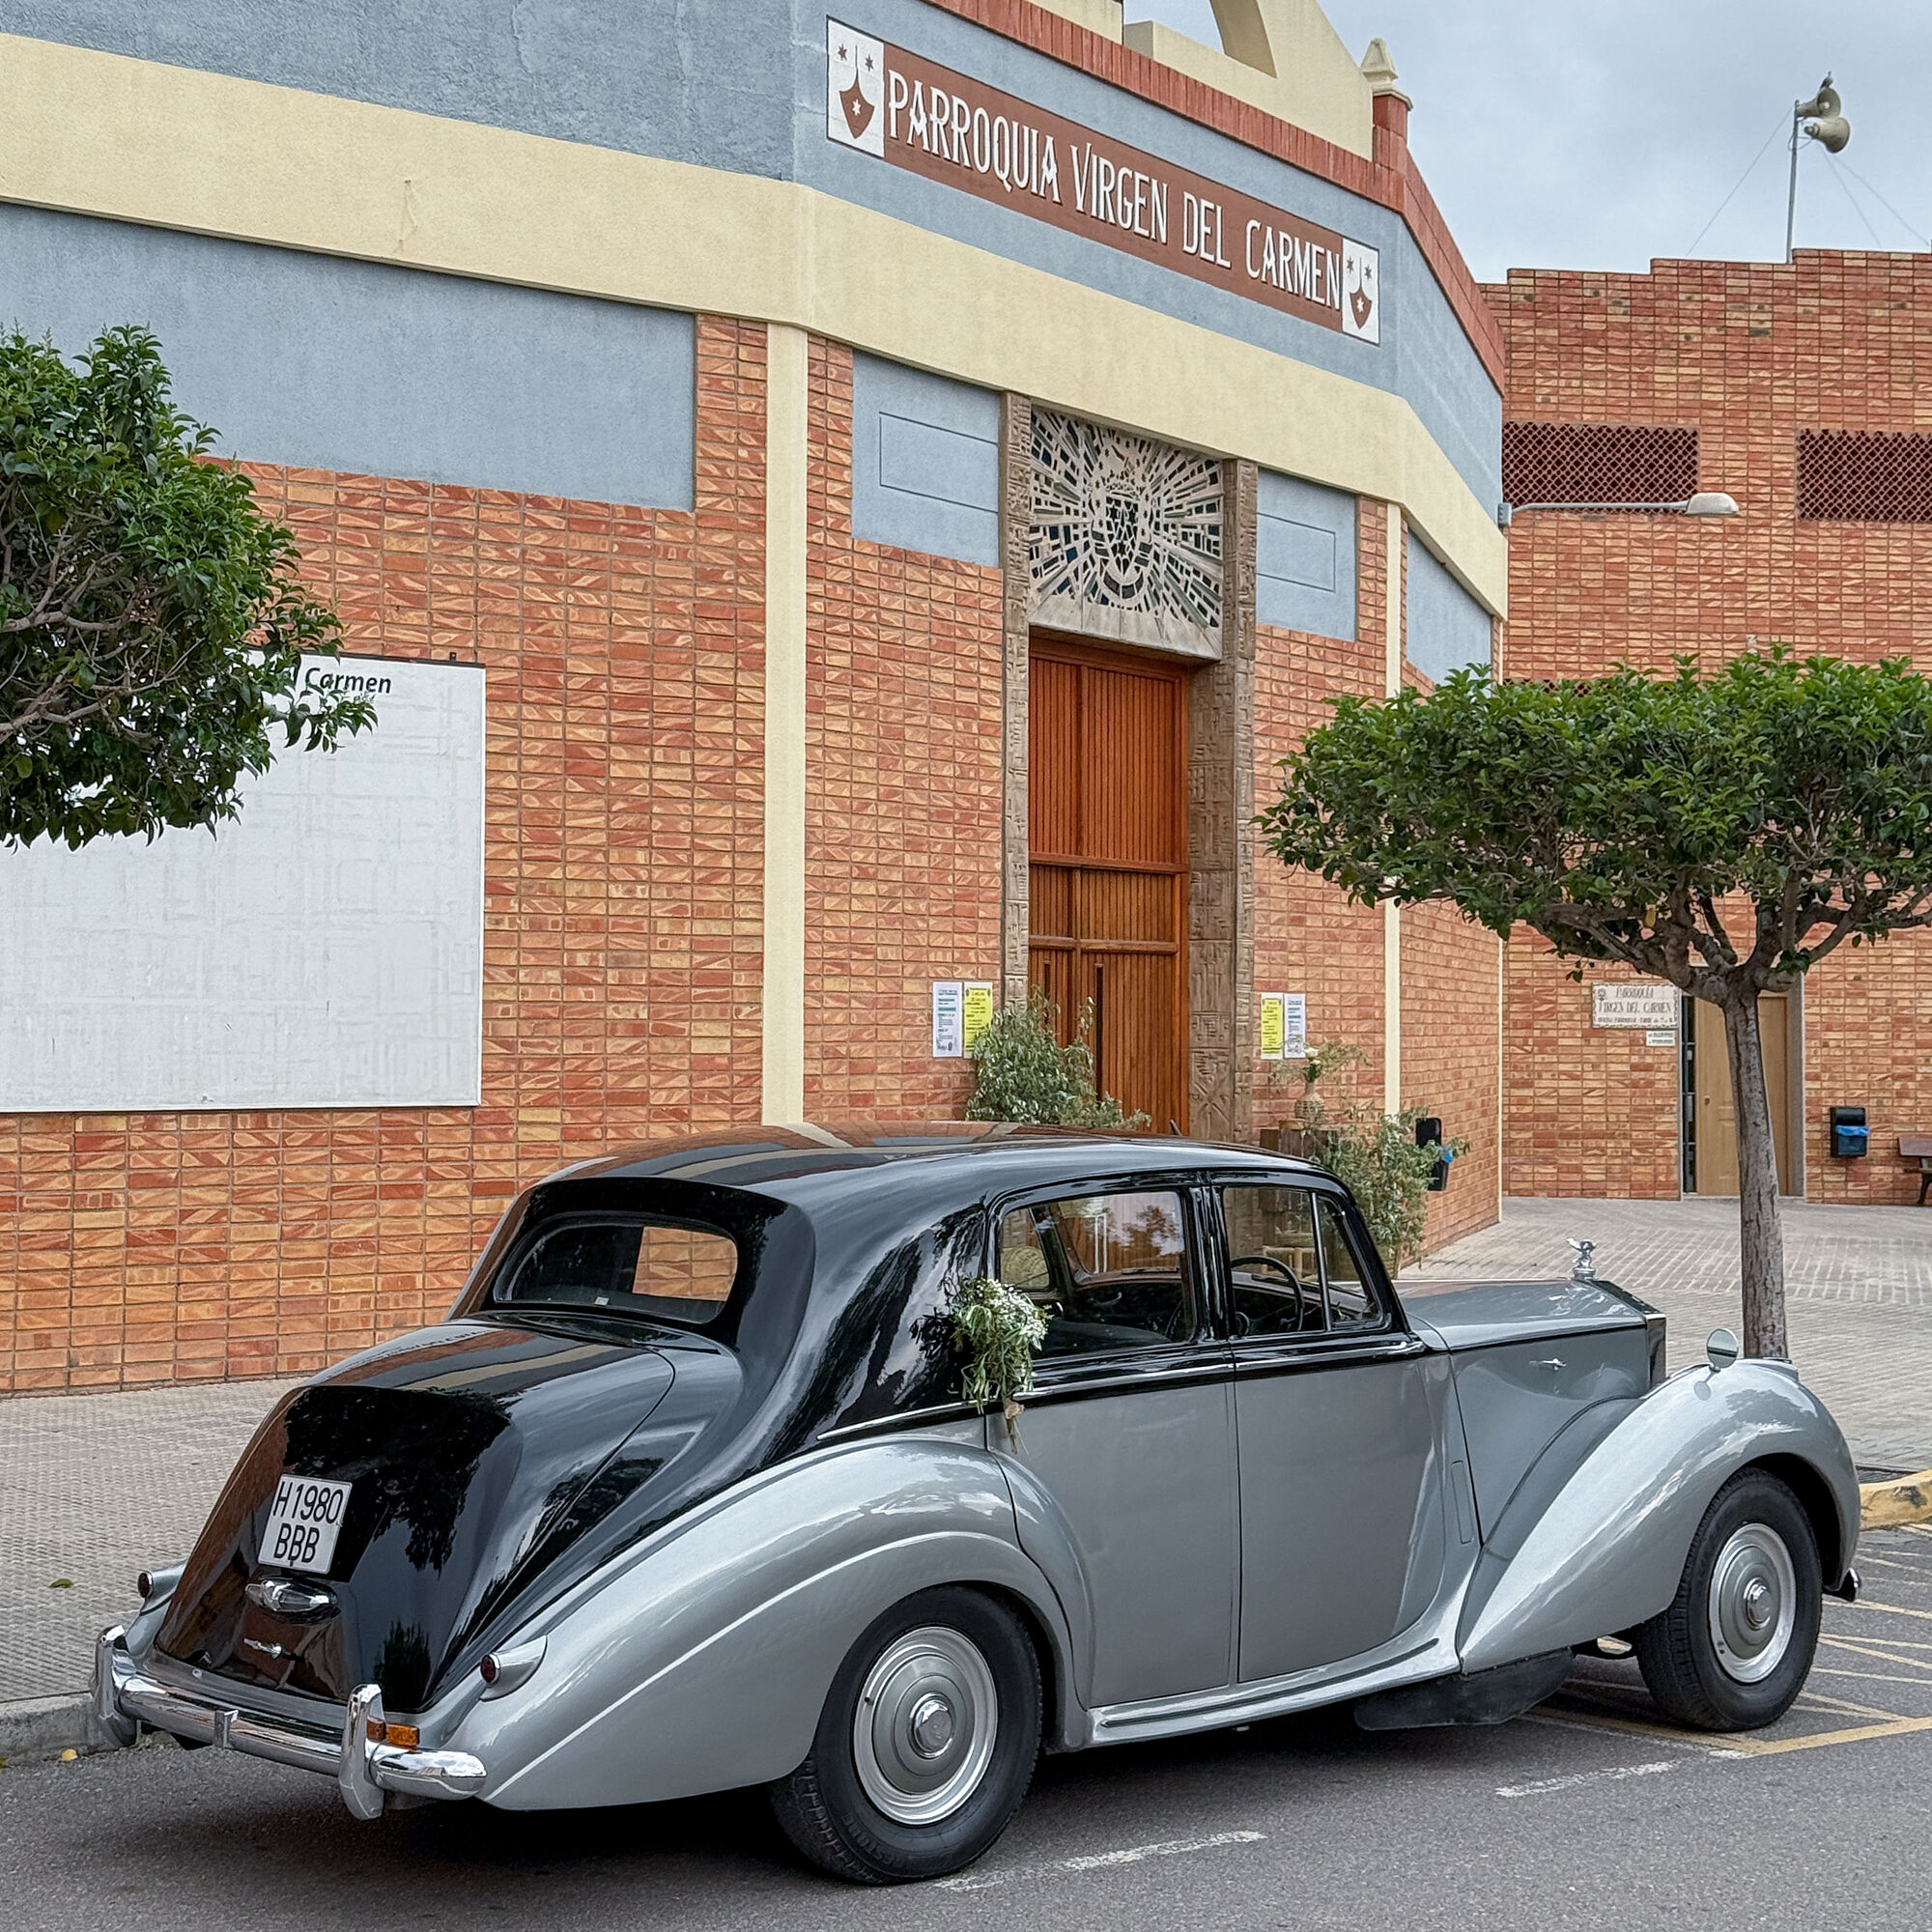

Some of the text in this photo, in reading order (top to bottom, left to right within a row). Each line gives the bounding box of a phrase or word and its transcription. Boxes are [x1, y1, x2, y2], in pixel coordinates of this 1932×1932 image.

[888, 69, 1341, 311] PARROQUIA VIRGEN DEL CARMEN
[305, 668, 391, 694] Carmen
[274, 1523, 320, 1563] BBB
